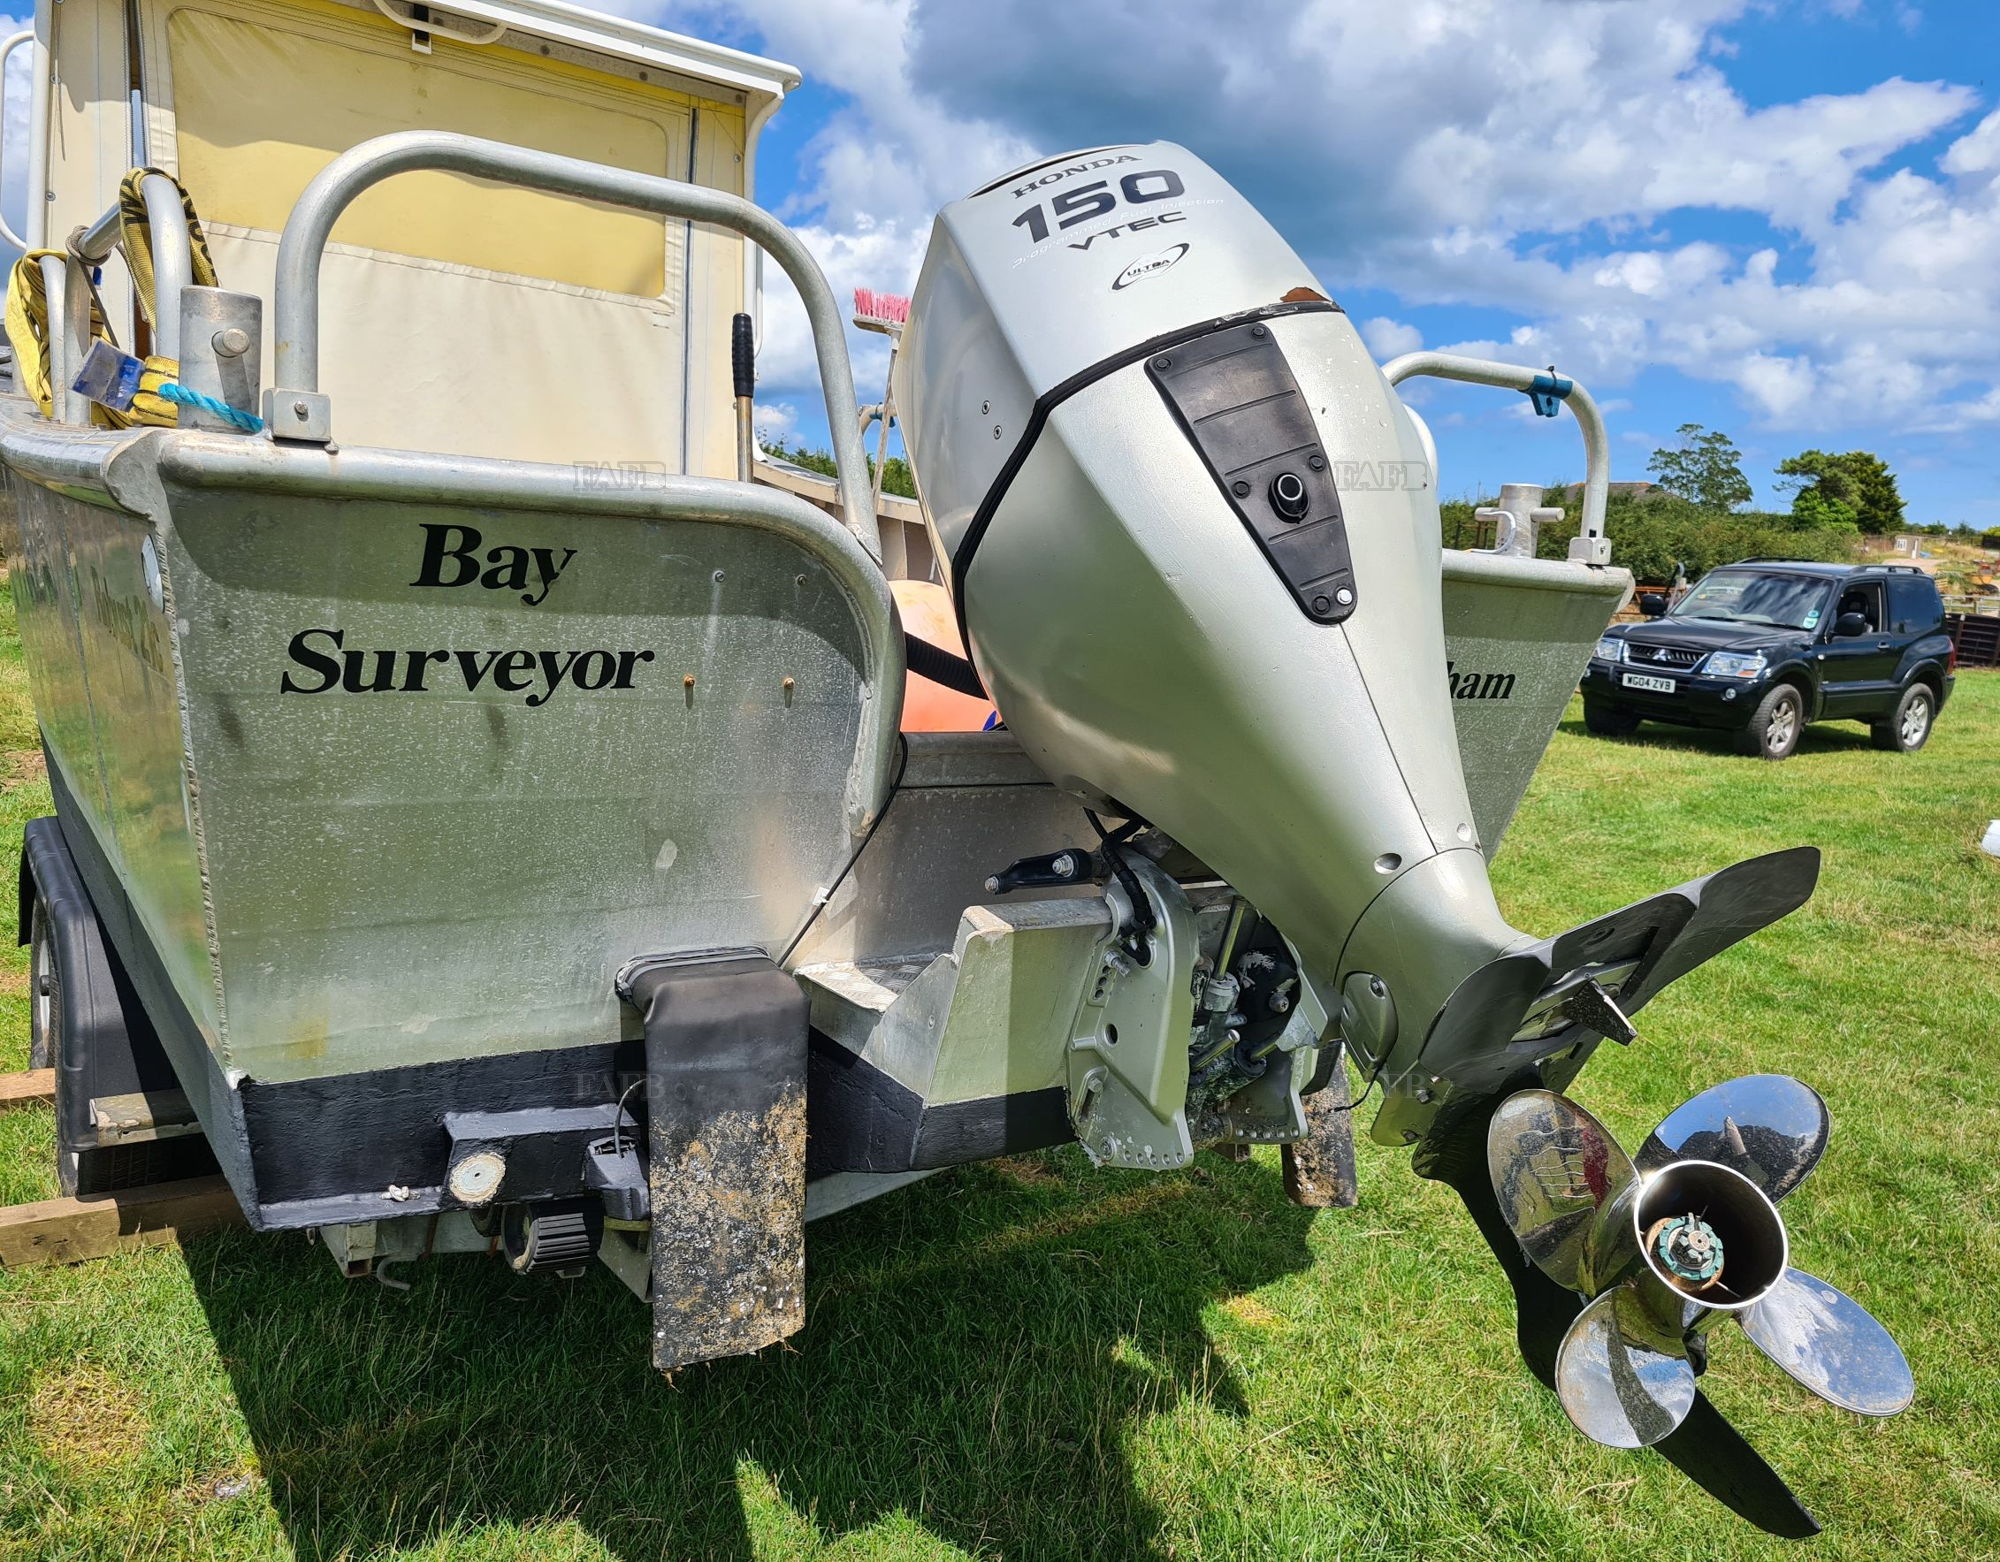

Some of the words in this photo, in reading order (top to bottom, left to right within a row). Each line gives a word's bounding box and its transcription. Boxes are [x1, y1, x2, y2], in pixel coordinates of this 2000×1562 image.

[1011, 155, 1142, 199] HONDA
[1012, 169, 1185, 243] 150
[1119, 206, 1152, 221] Fuel
[1160, 199, 1224, 210] Injection
[1067, 211, 1187, 250] VTEC
[1127, 259, 1170, 276] ULTRA
[409, 523, 577, 606] Bay
[280, 629, 655, 707] Surveyor
[1627, 675, 1650, 687] WG04
[1652, 680, 1671, 690] ZVB
